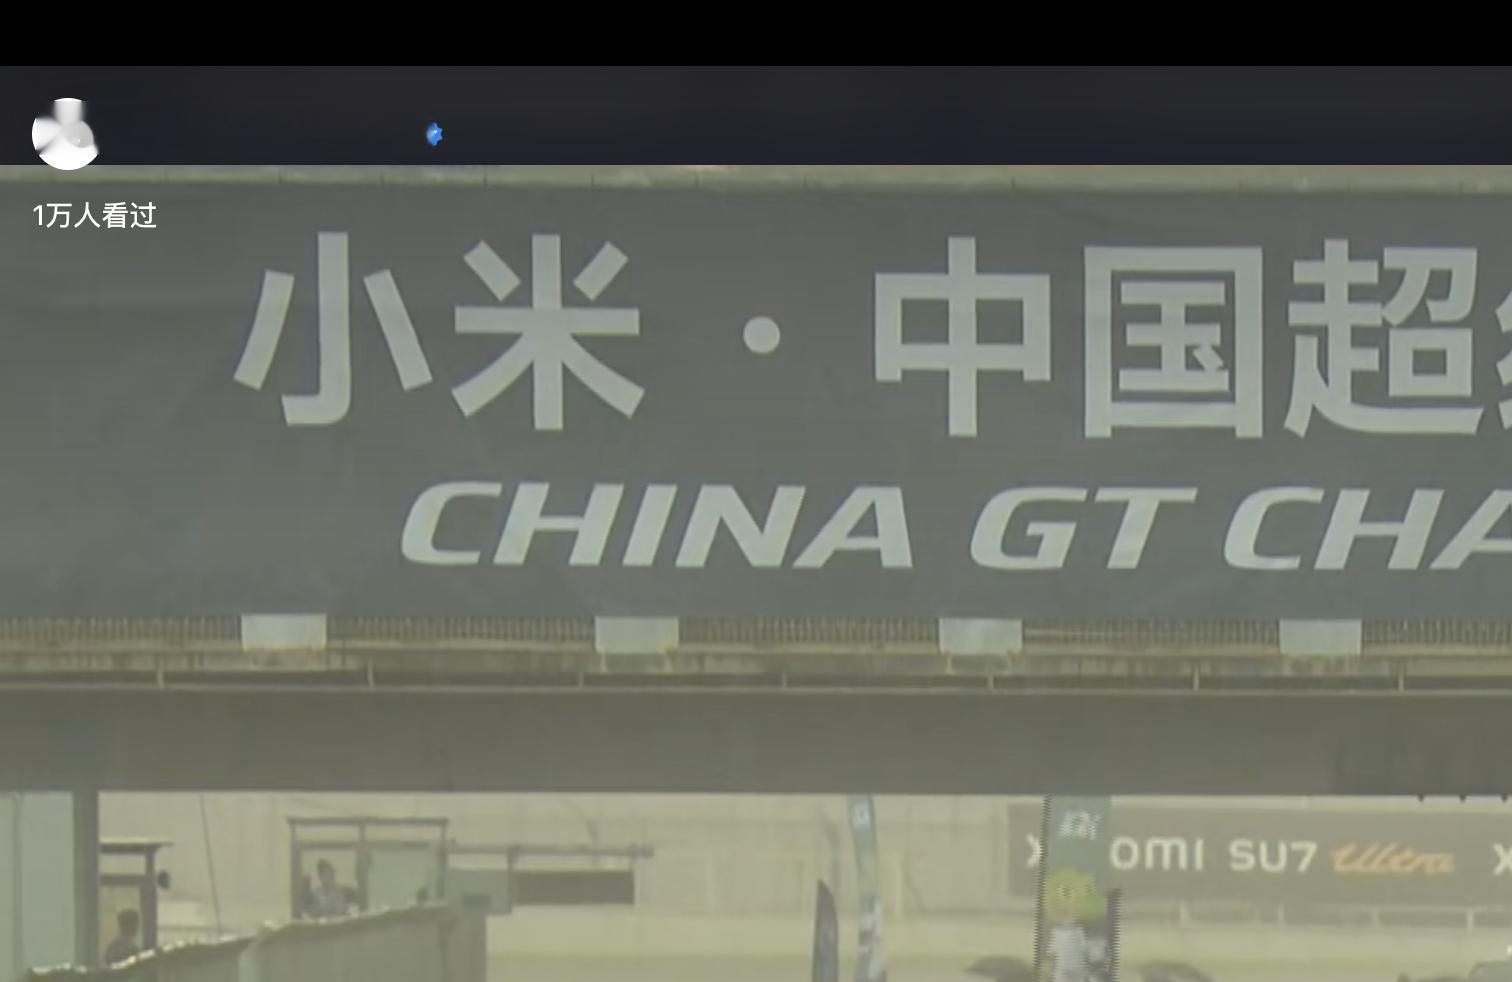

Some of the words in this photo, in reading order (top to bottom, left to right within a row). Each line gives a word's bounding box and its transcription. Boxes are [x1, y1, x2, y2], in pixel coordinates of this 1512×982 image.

[400, 481, 914, 570] CHINA
[968, 486, 1198, 570] GT
[1228, 837, 1318, 873] SU7
